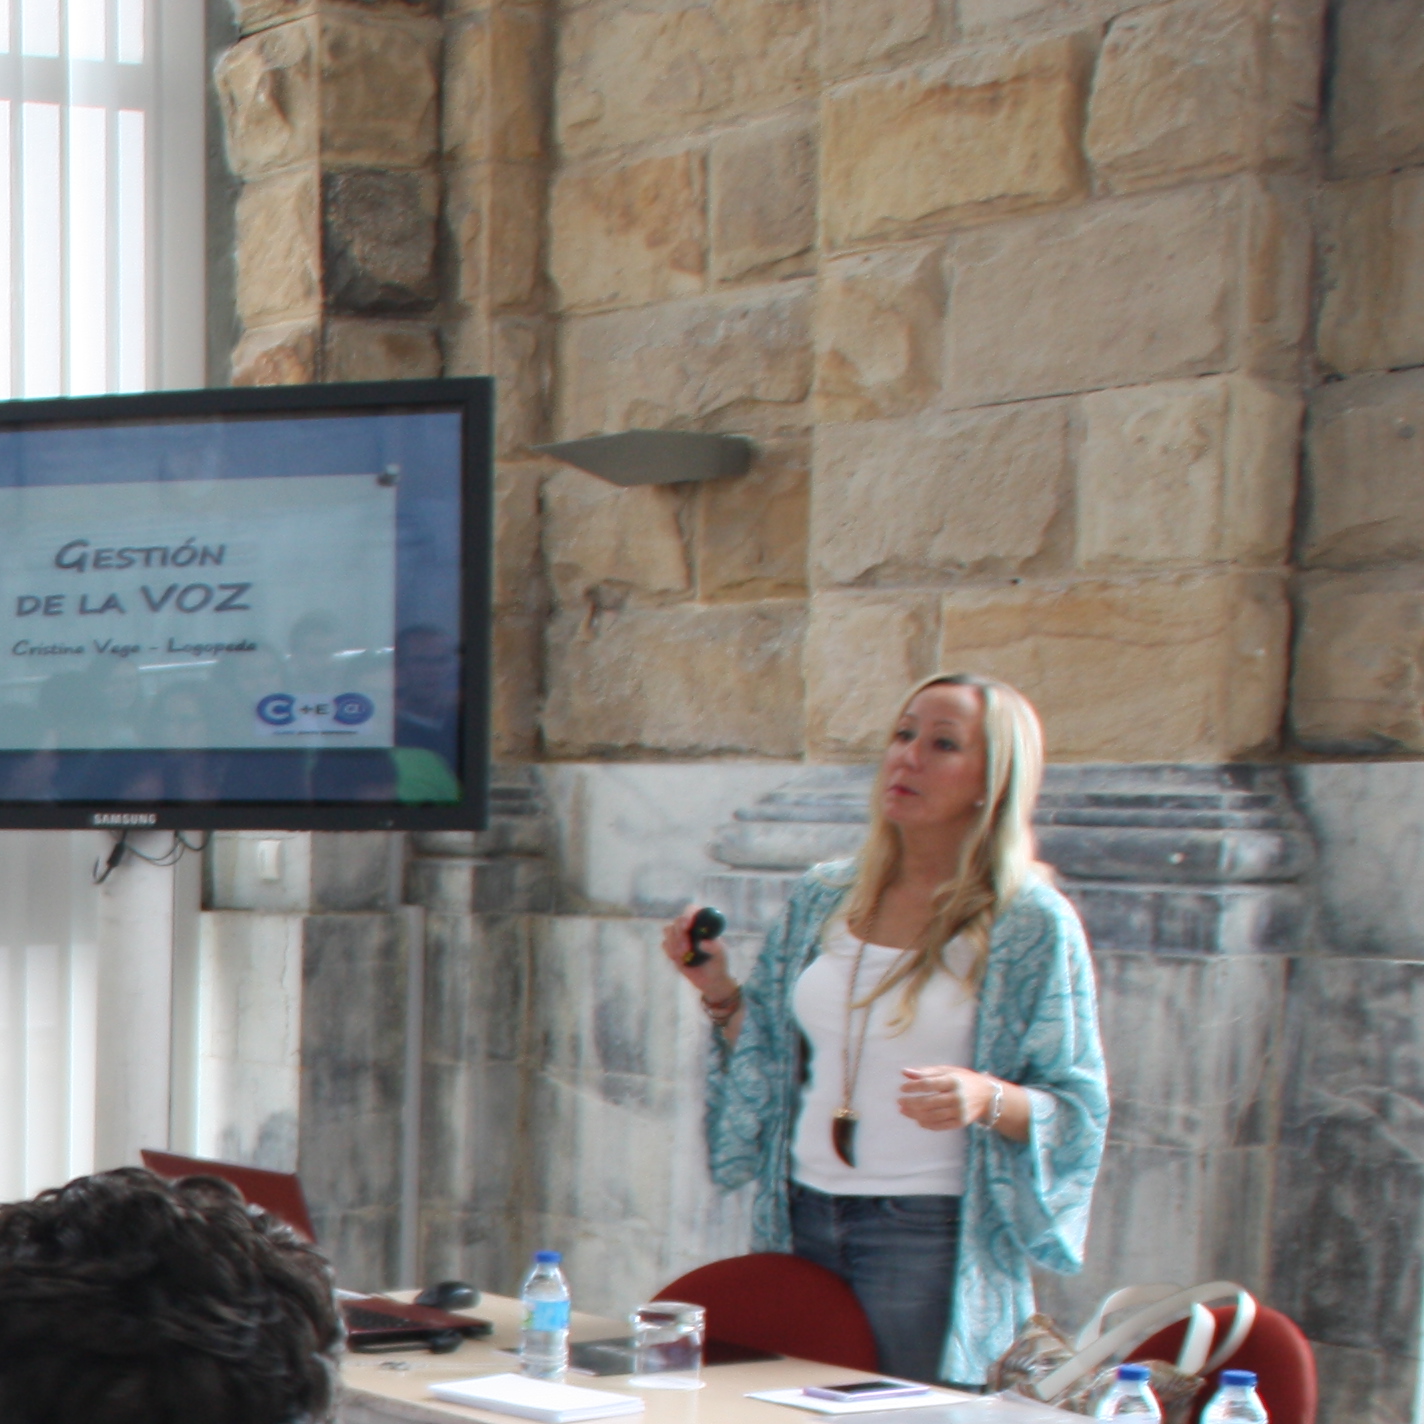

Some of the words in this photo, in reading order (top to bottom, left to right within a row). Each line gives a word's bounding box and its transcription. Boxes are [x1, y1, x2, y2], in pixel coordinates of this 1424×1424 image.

[54, 537, 225, 573] GESTIÓN
[15, 595, 66, 617] DE
[78, 593, 126, 615] LA
[140, 582, 253, 614] VOZ
[12, 639, 85, 656] Cristina
[93, 638, 140, 657] Vega
[167, 637, 257, 656] Logopeda
[93, 812, 157, 826] SAMSUNG
